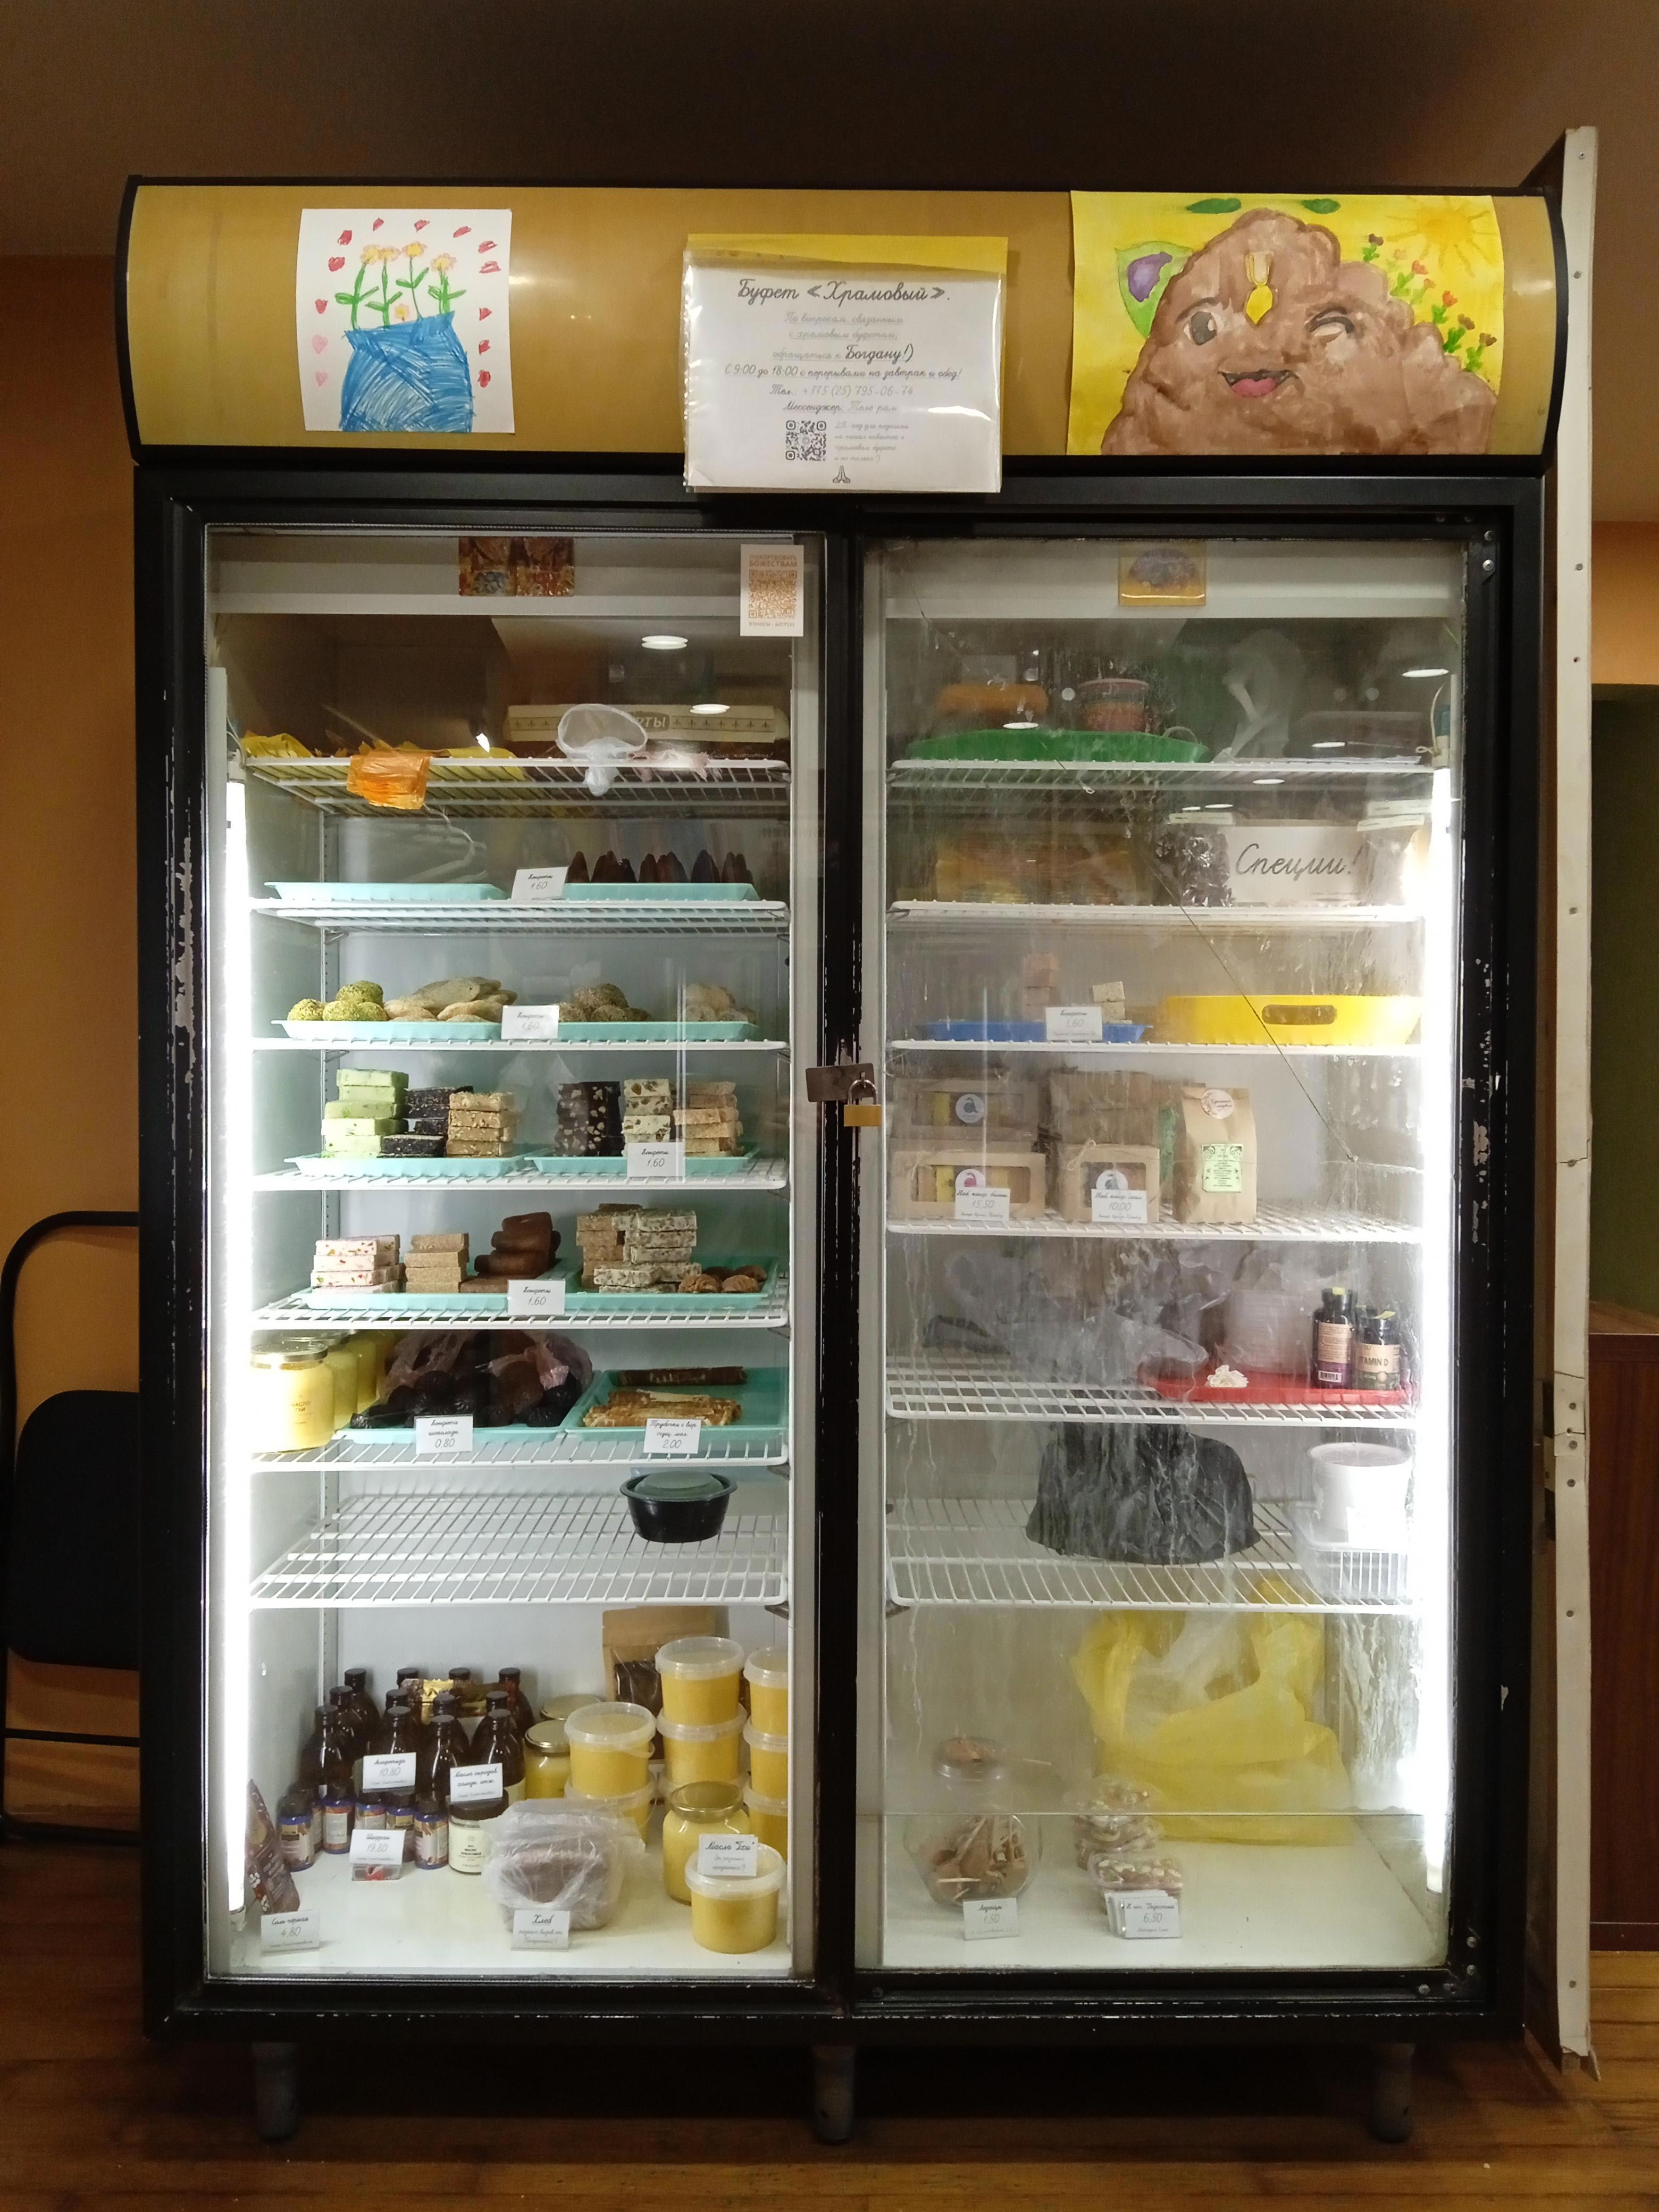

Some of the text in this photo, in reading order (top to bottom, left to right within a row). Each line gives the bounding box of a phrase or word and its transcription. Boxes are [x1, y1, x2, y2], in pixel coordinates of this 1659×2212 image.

[738, 279, 800, 306] Буфет
[784, 312, 798, 322] По
[799, 328, 848, 340] храмовым
[773, 348, 832, 362] обращаться
[845, 343, 914, 364] Богдану!)
[725, 364, 733, 374] С
[757, 369, 768, 379] до
[773, 366, 798, 375] 18:00
[808, 367, 865, 380] перерывами
[883, 367, 926, 380] завтрак
[938, 368, 962, 381] обед!
[803, 386, 830, 395] +375
[831, 385, 851, 398] (25)
[783, 400, 843, 415] Мессенджер:
[636, 716, 666, 728] РТЫ
[1235, 843, 1363, 881] Специи!
[531, 882, 548, 890] 1.60
[521, 1021, 540, 1030] 1.60
[647, 1158, 665, 1168] 1.60
[973, 1200, 995, 1209] 15.50
[1109, 1202, 1132, 1211] 10.00
[528, 1296, 547, 1306] 1.60
[650, 1420, 679, 1429] Трубочки
[435, 1438, 455, 1448] 0.80
[662, 1439, 682, 1448] 2.00
[380, 1766, 401, 1777] 10.80
[705, 1841, 732, 1850] Масло
[532, 1914, 555, 1924] Хлеб
[984, 1913, 1000, 1924] 1.50
[1144, 1912, 1162, 1923] 6.50
[281, 1926, 301, 1938] 4.80
